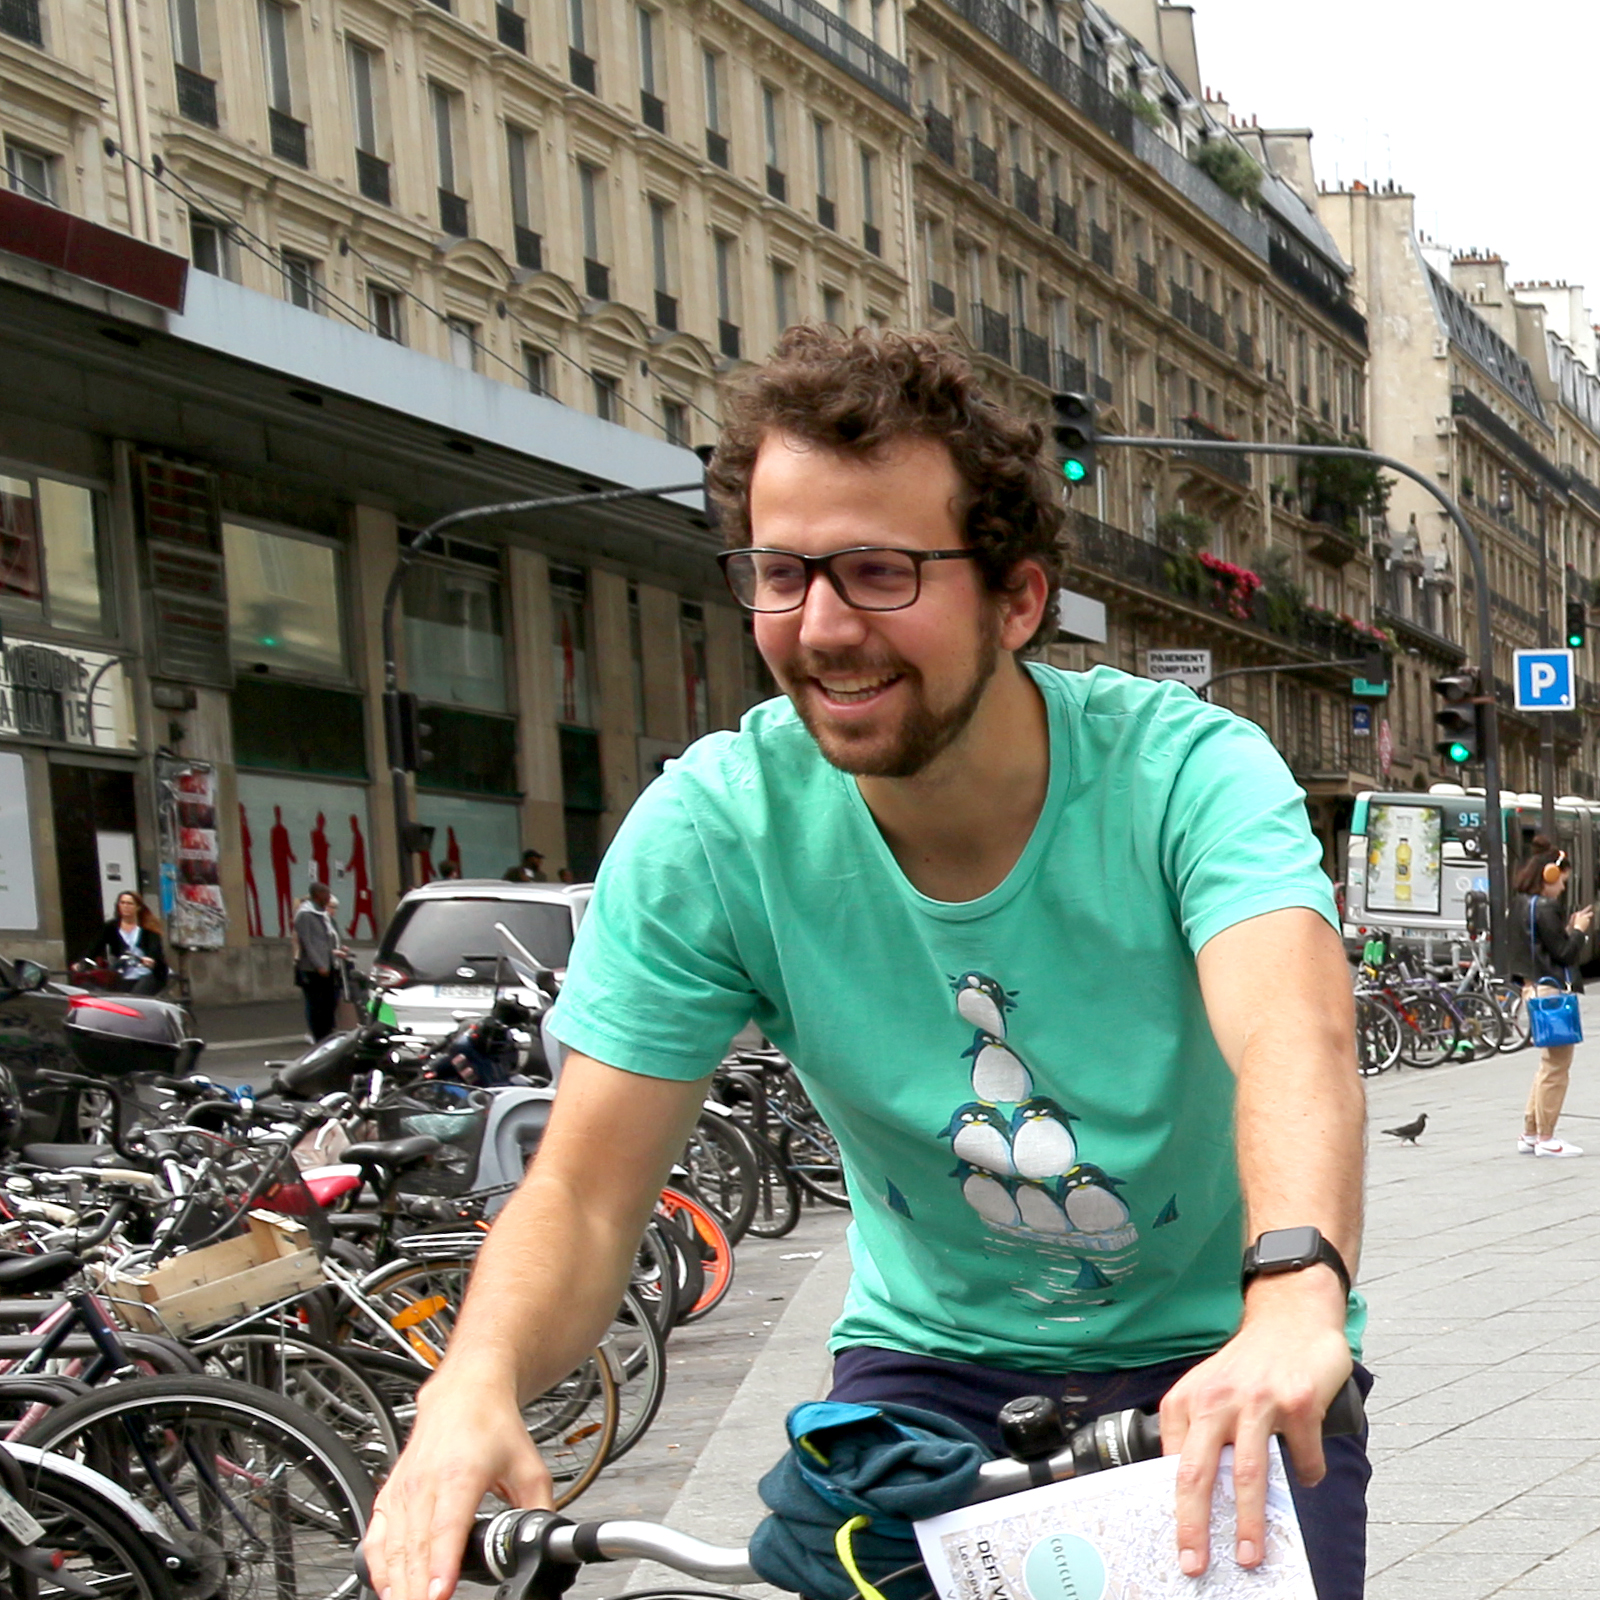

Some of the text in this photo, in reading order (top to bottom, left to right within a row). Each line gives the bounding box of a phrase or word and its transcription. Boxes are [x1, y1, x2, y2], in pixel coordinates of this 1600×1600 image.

[1149, 653, 1206, 662] PAIEMENT
[1149, 665, 1206, 674] COMPTANT
[1530, 662, 1557, 698] P
[1458, 812, 1481, 827] 95
[976, 1540, 1001, 1582] DÉFI
